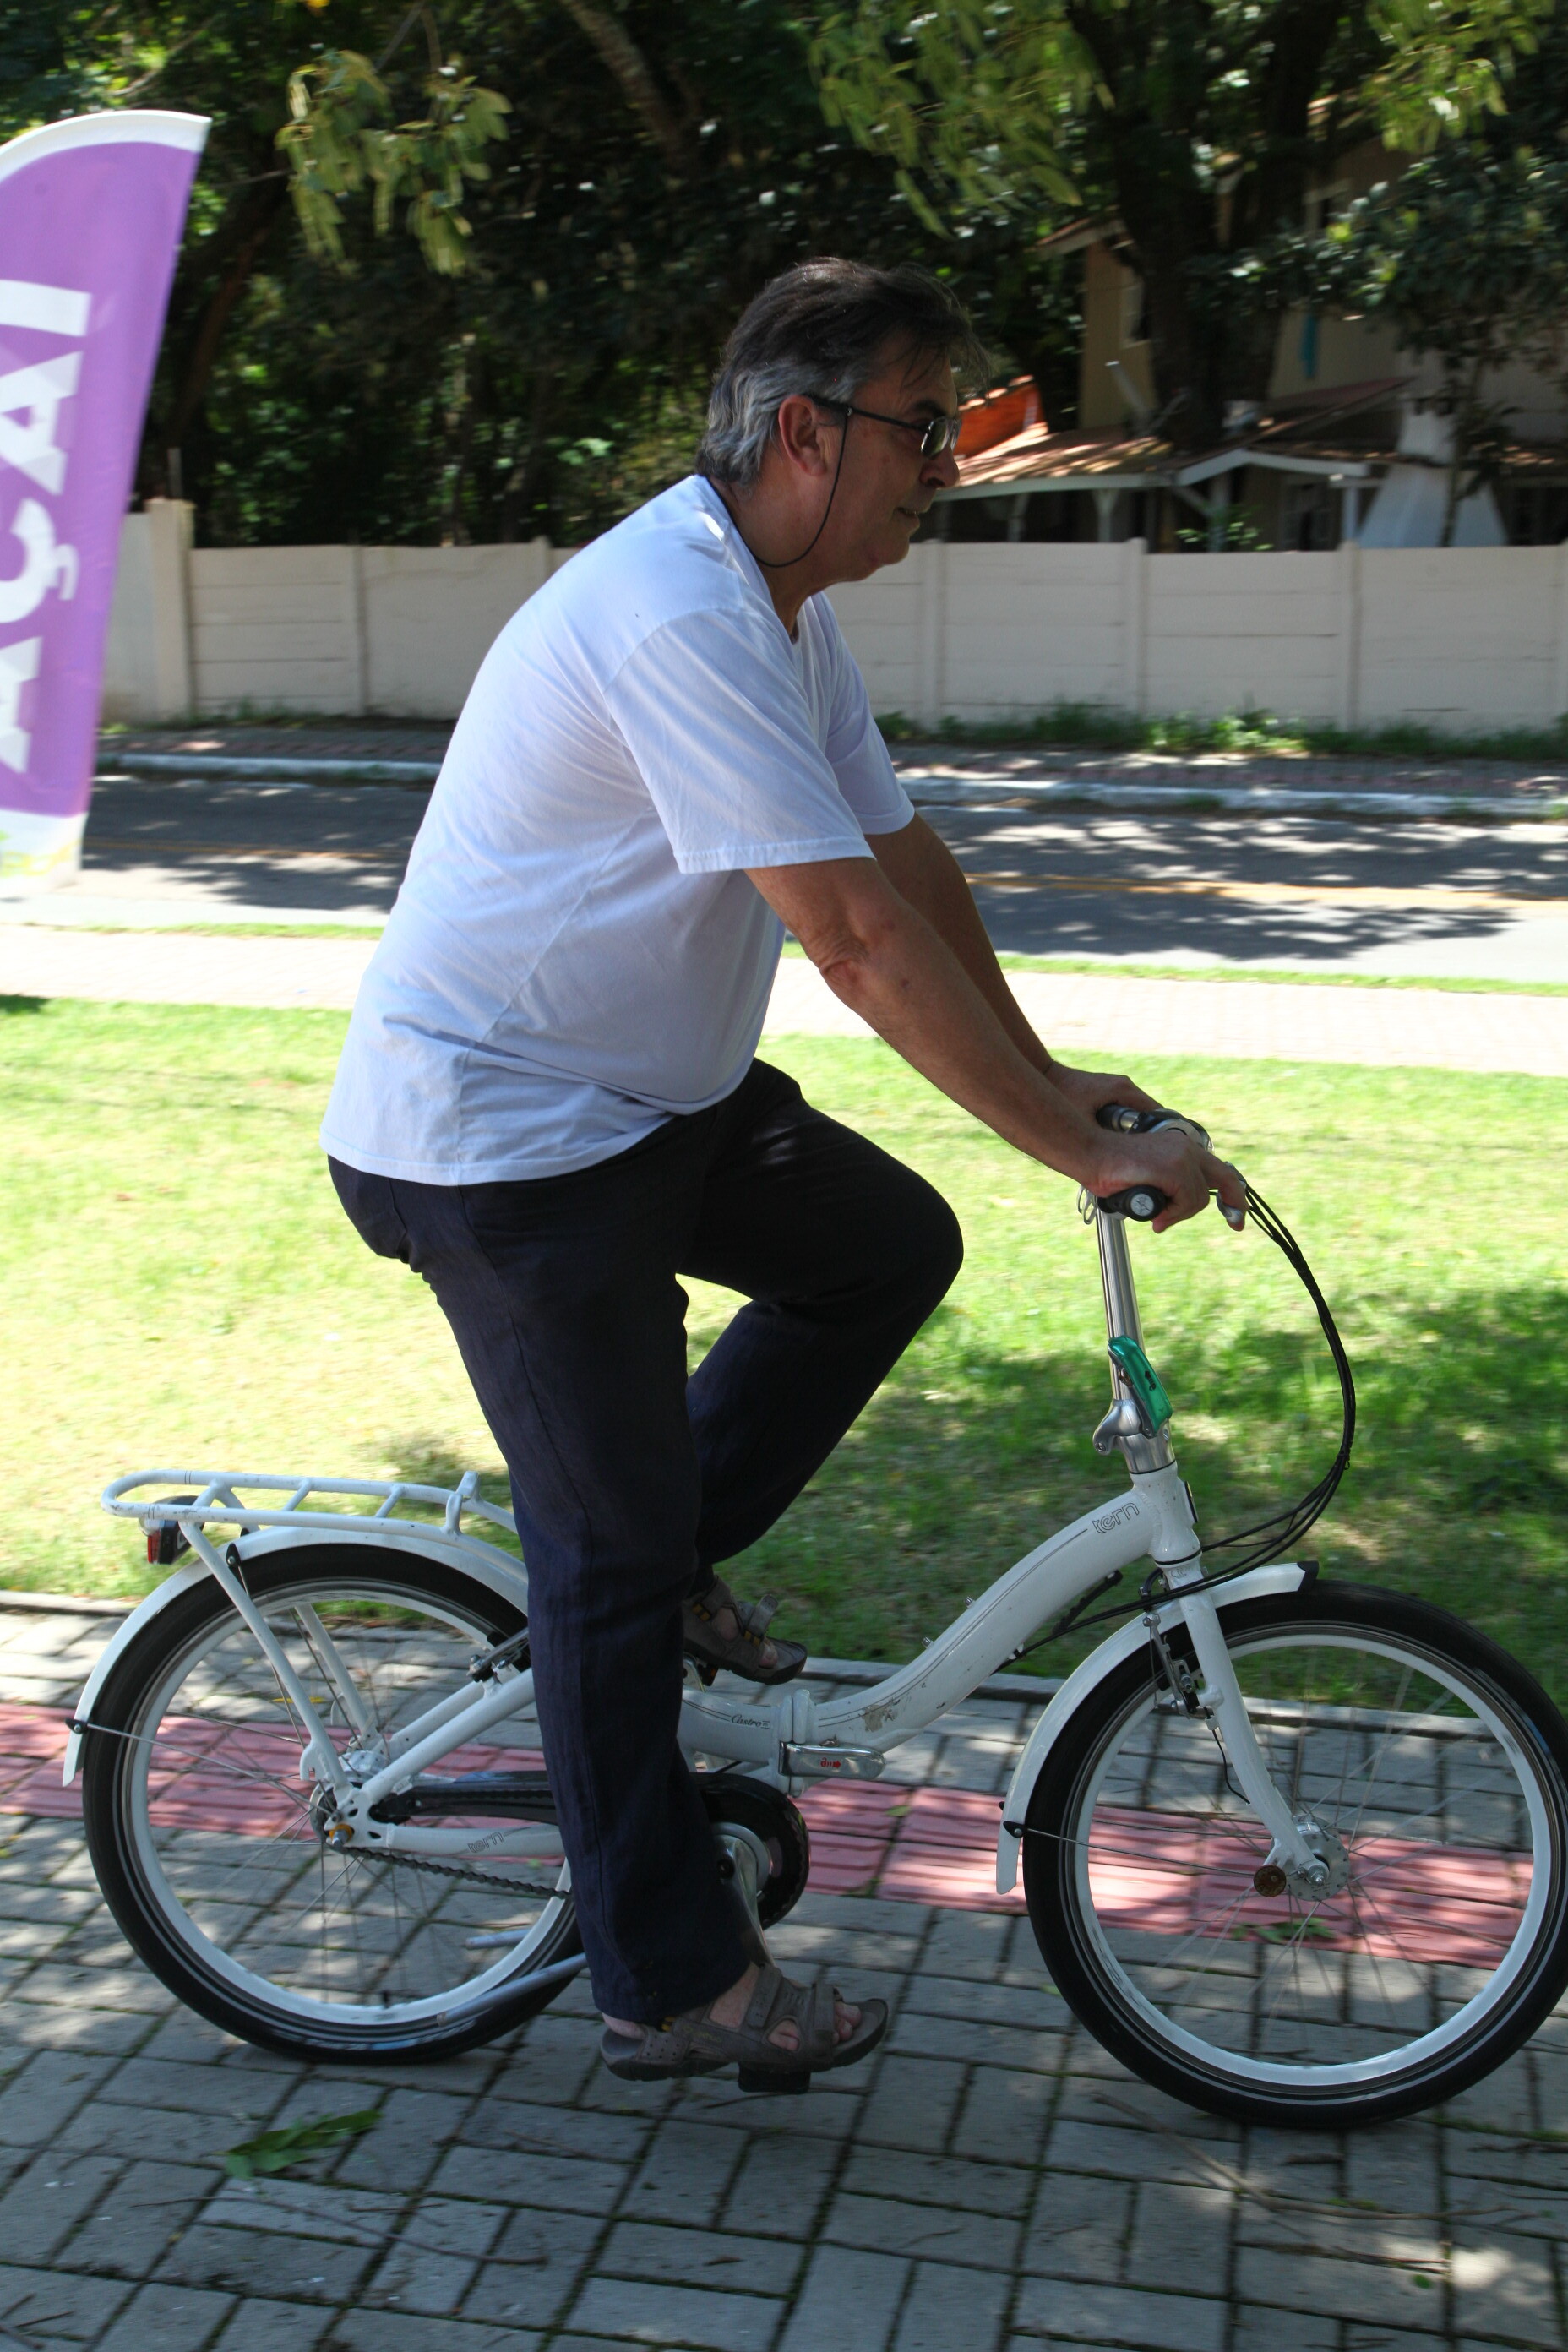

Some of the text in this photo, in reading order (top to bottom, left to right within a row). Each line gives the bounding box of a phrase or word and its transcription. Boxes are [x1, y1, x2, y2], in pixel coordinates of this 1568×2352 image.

[1092, 1502, 1140, 1533] tern
[732, 1714, 761, 1727] Castro
[468, 1832, 504, 1853] tern
